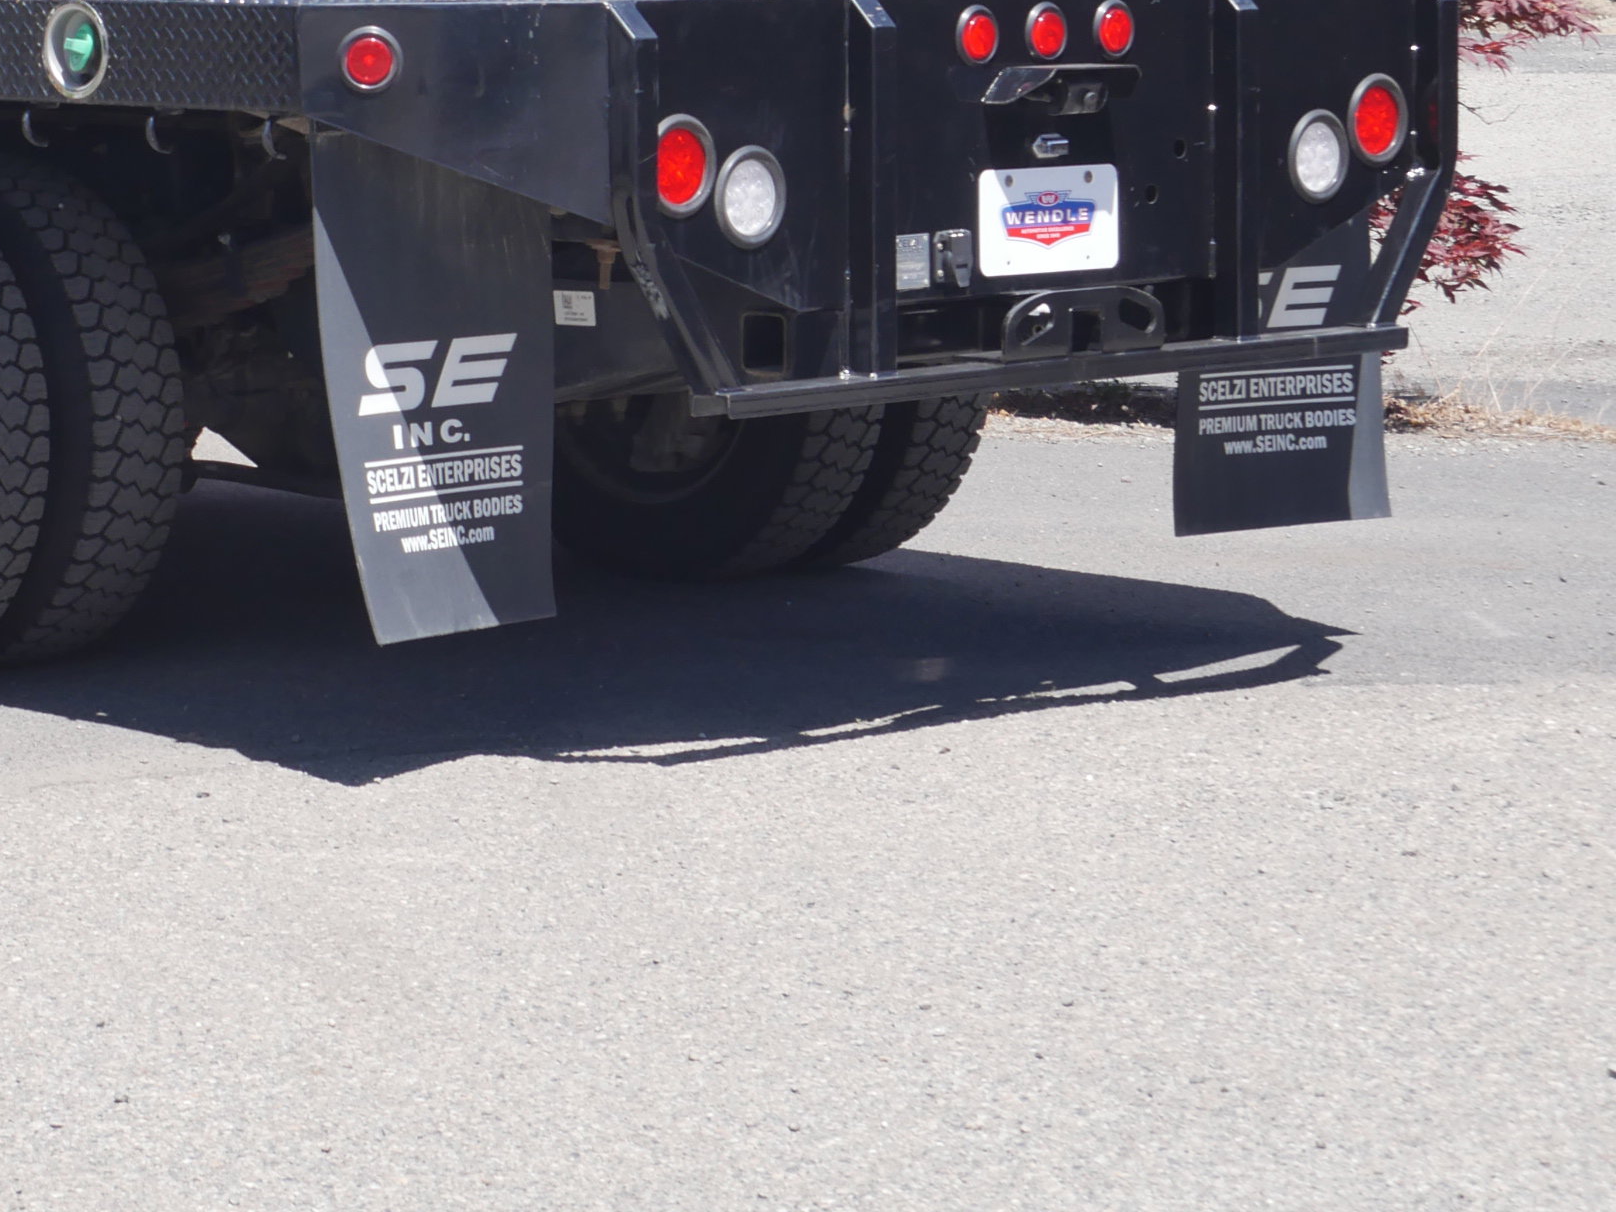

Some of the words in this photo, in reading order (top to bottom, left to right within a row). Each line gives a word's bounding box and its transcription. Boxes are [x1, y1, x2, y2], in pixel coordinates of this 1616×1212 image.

[1006, 208, 1088, 224] WENDLE
[358, 332, 518, 416] SE
[1199, 378, 1247, 403] SCELZI
[1250, 372, 1354, 399] ENTERPRISES
[392, 418, 471, 450] INC.
[1198, 416, 1258, 436] PREMIUM
[1259, 412, 1303, 431] TRUCK
[1305, 408, 1357, 428] BODIES
[1223, 433, 1328, 456] www.SEINC.com
[366, 465, 416, 495] SCELZI
[417, 453, 523, 489] ENTERPRISES
[373, 504, 431, 532] PREMIUM
[430, 499, 474, 523] TRUCK
[473, 494, 523, 518] BODIES
[400, 523, 495, 554] www.SEINC.com
